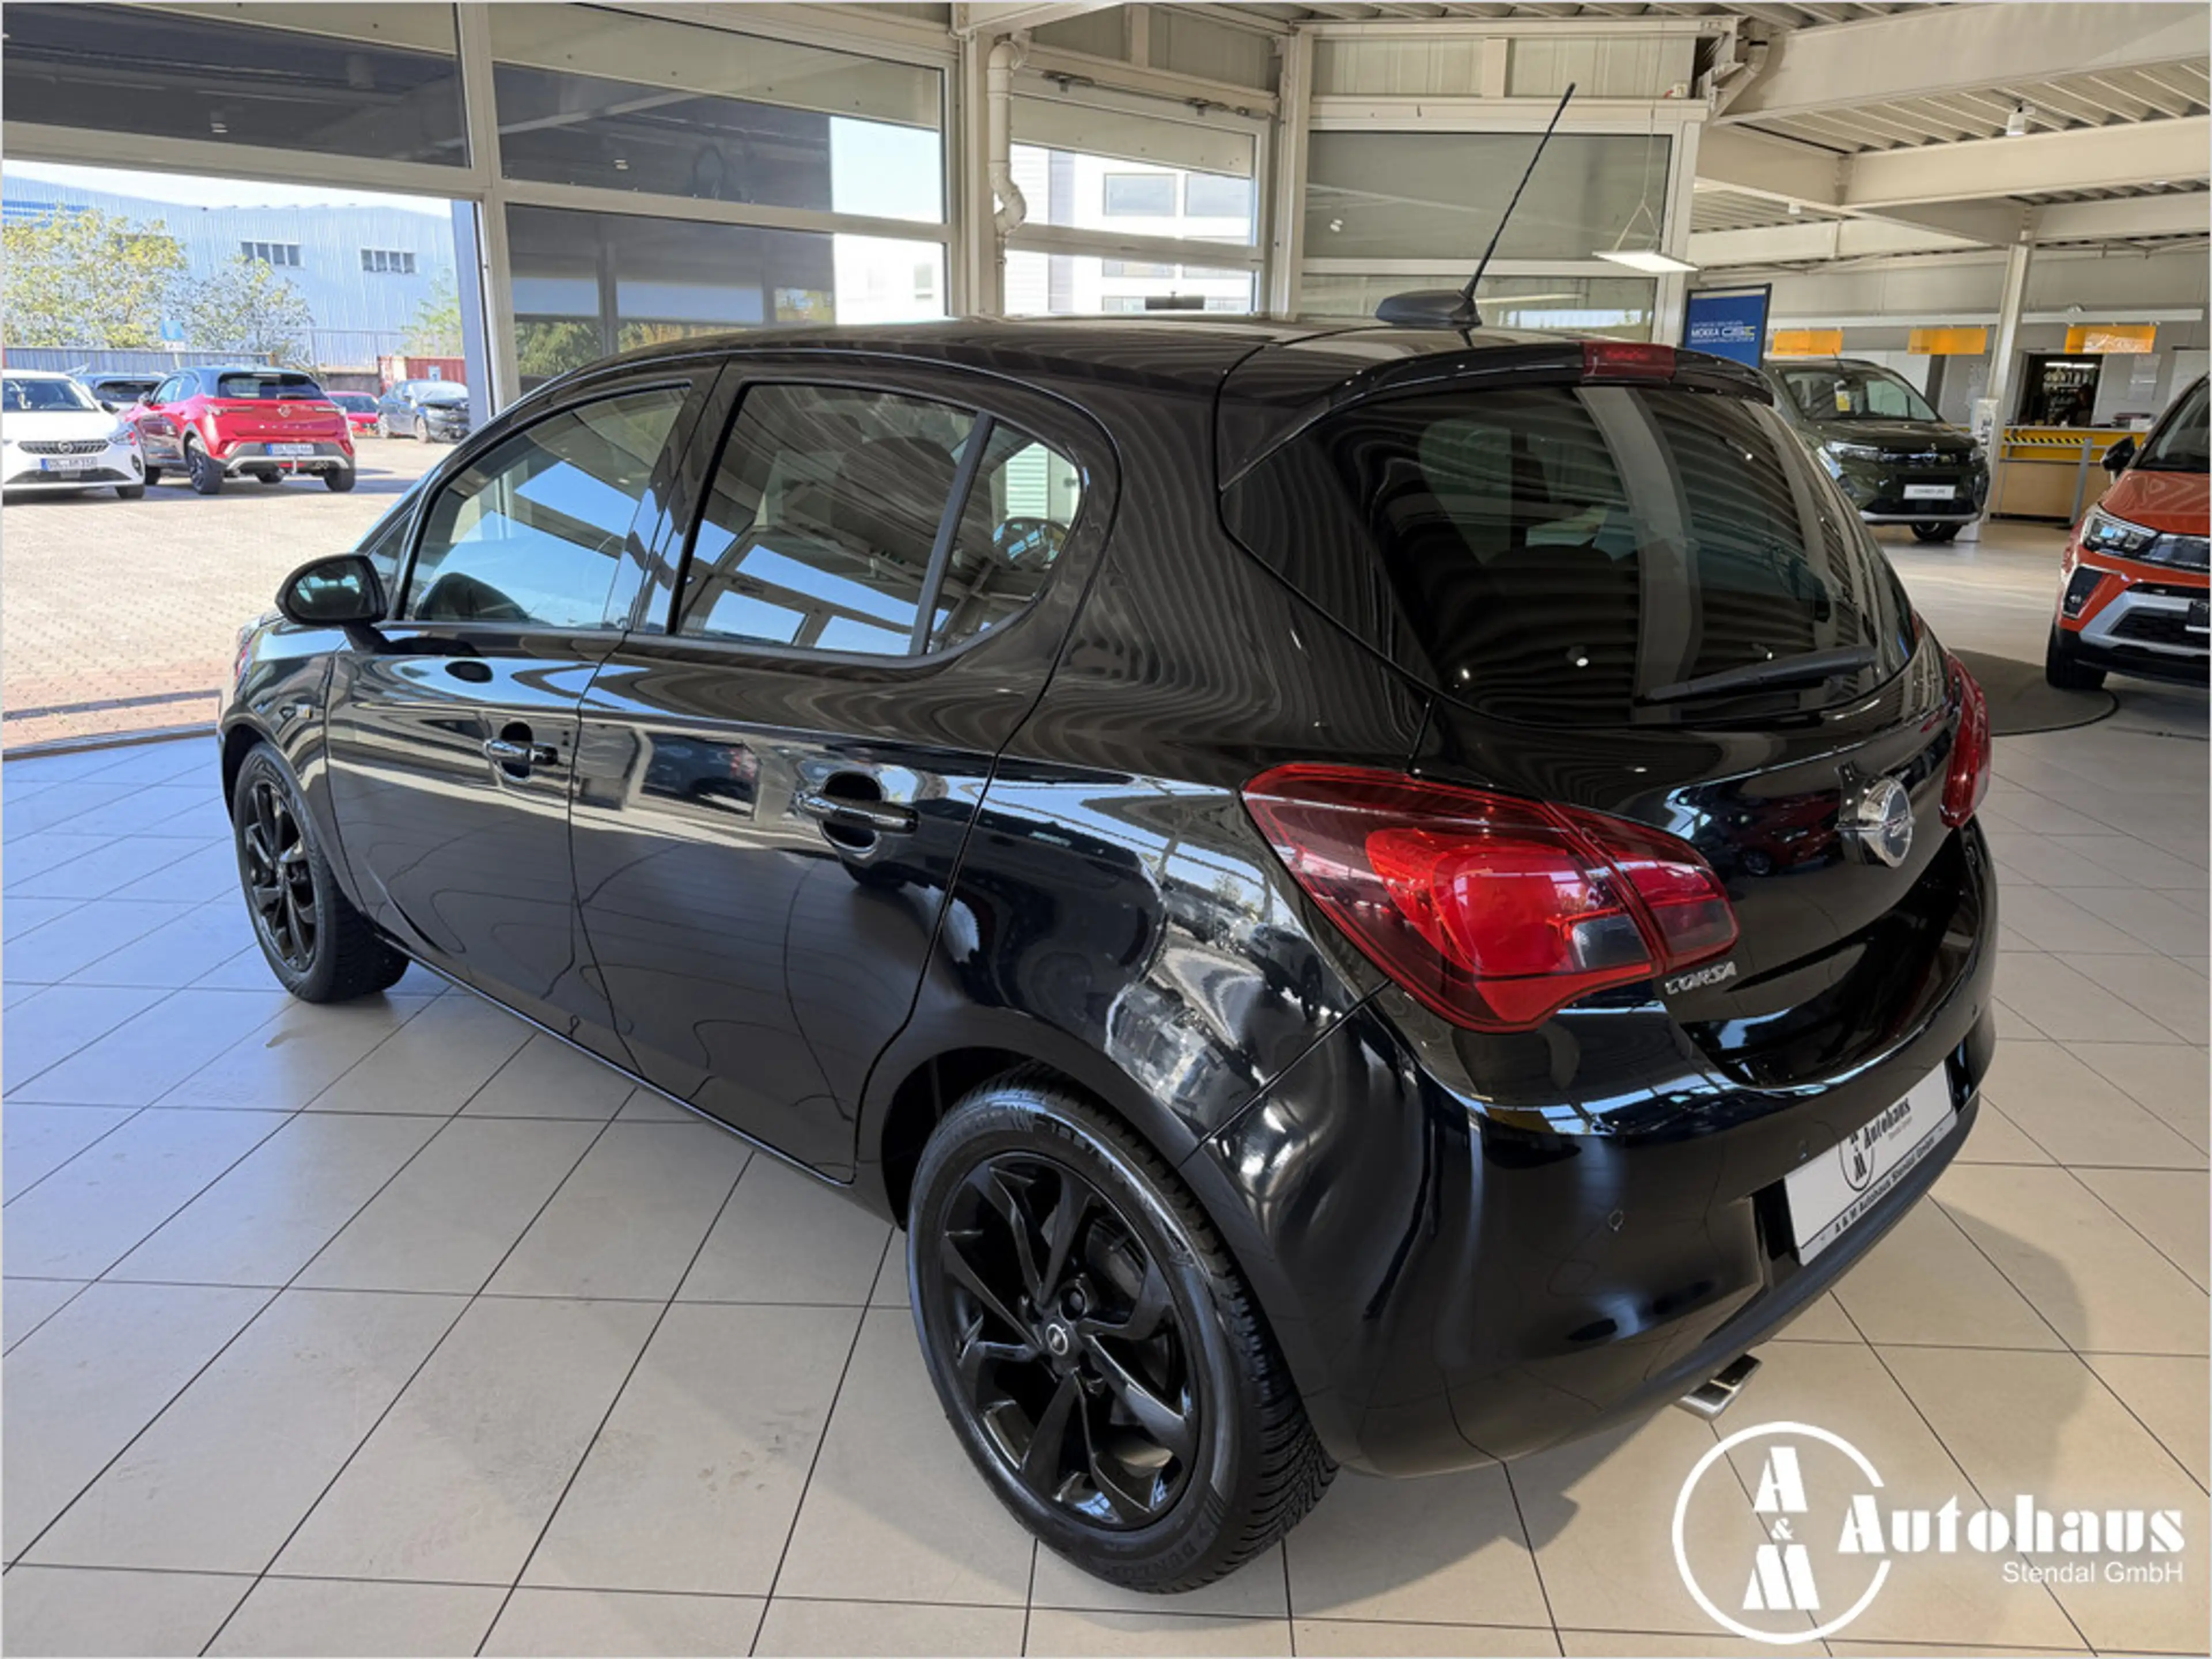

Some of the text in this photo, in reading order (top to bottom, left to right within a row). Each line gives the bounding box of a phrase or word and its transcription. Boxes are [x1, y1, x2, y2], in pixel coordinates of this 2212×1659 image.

[1691, 328, 1719, 338] MOKKA
[1665, 961, 1737, 995] CORSA
[1864, 1097, 1911, 1150] Autohaus
[1859, 1180, 1891, 1212] Autohaus
[1892, 1154, 1915, 1182] Stendal
[1916, 1137, 1935, 1158] GmbH
